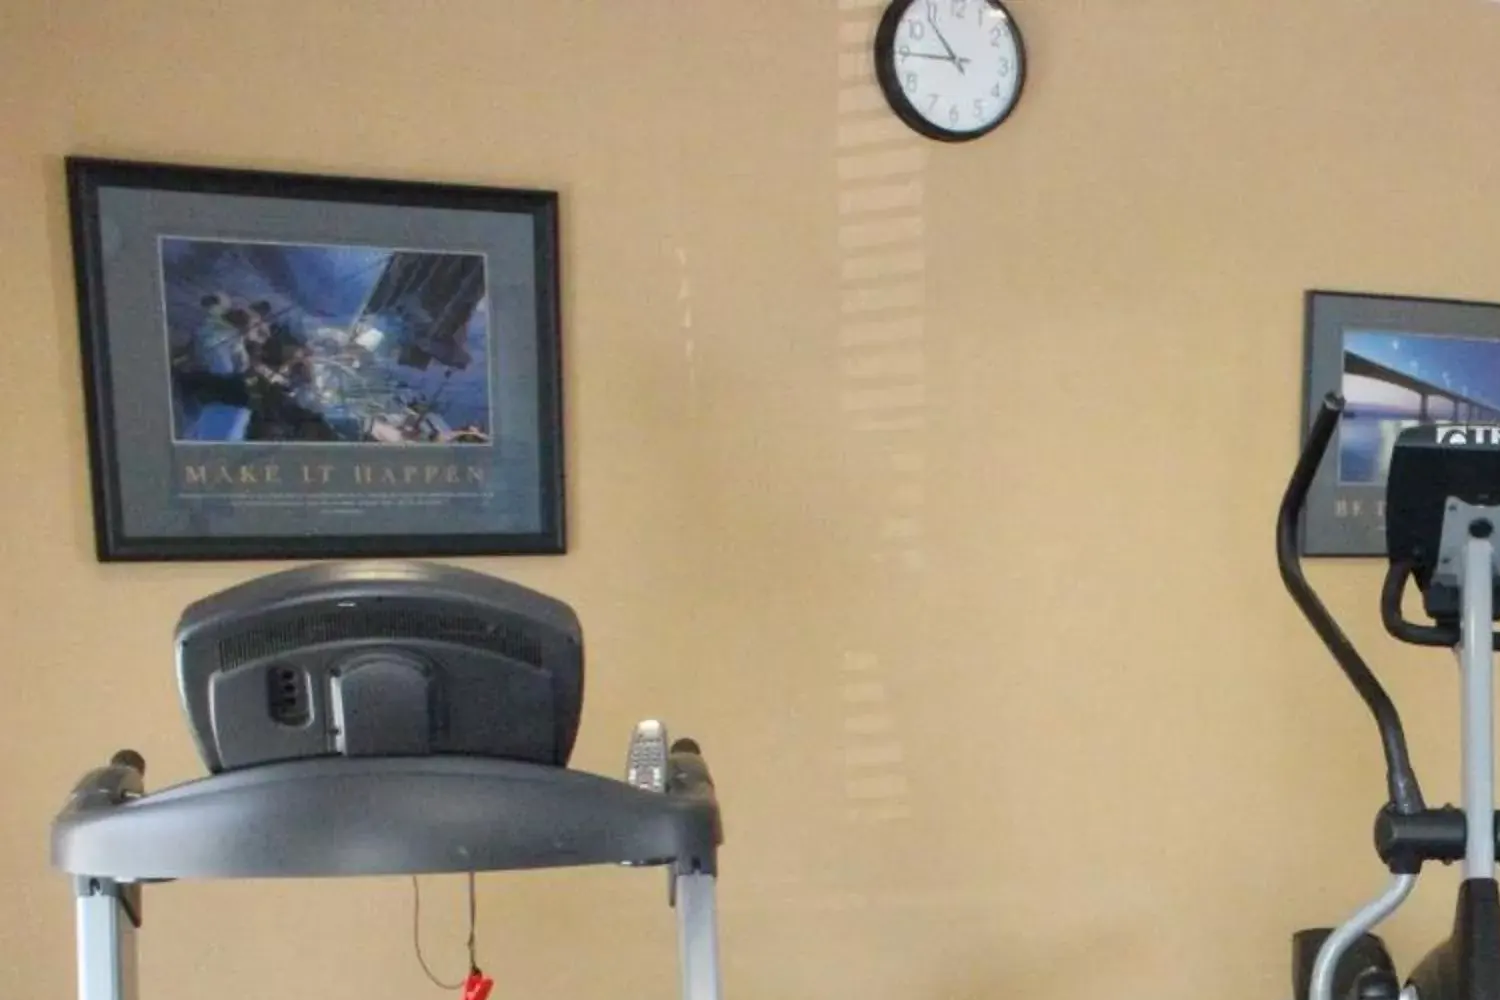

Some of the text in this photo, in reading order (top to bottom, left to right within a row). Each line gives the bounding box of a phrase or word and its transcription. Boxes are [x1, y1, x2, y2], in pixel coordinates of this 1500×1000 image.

[952, 2, 966, 19] 12
[909, 20, 925, 41] 10
[990, 25, 1001, 48] 2
[998, 58, 1009, 77] 3
[905, 73, 918, 93] 8
[991, 82, 1000, 98] 4
[928, 93, 939, 111] 7
[973, 99, 983, 119] 5
[949, 105, 959, 122] 6
[185, 464, 486, 484] MAKE IT HAPPEN
